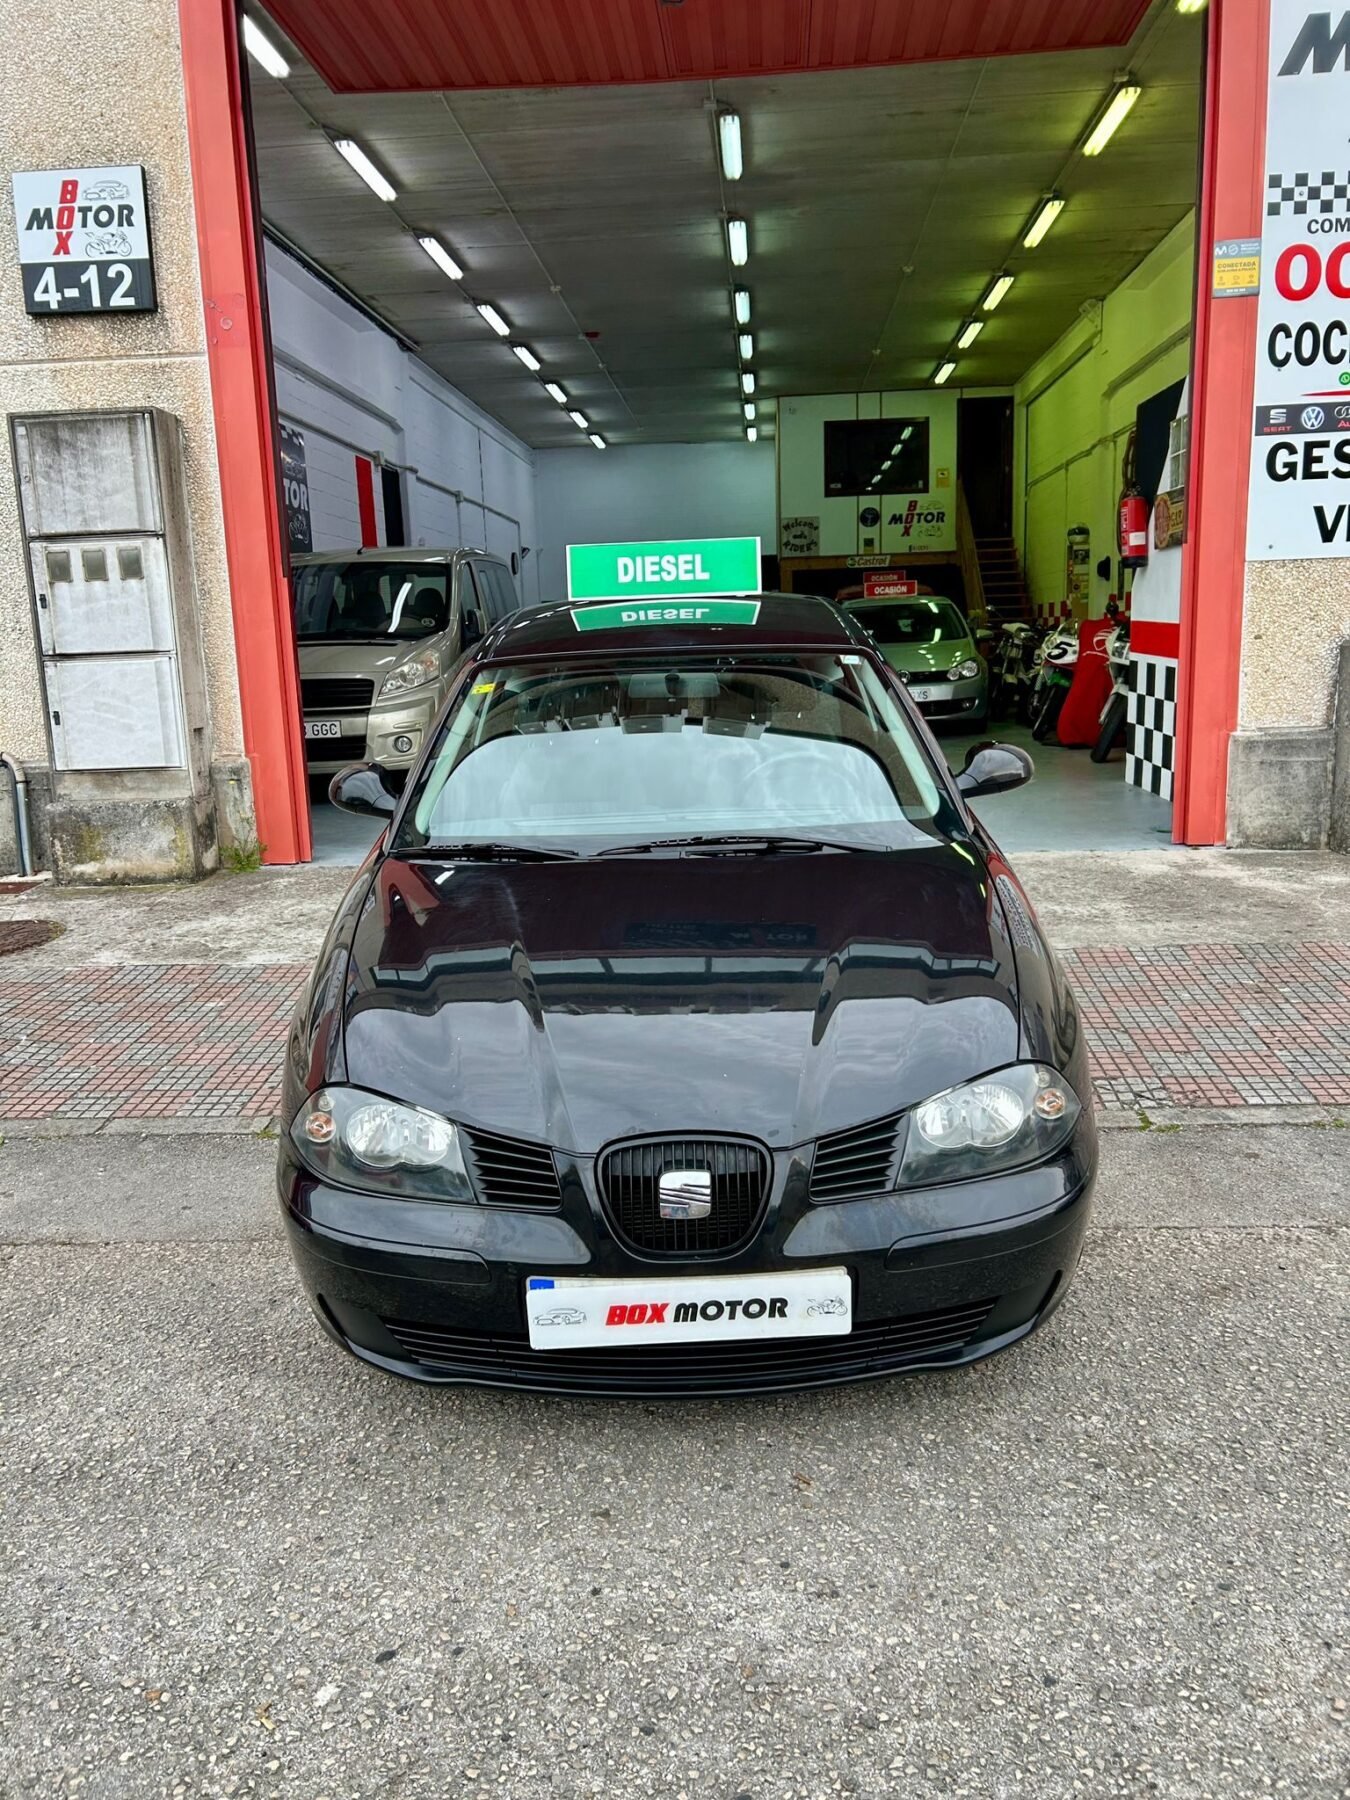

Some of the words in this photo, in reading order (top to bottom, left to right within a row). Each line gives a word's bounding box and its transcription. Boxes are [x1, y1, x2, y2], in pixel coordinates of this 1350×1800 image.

[25, 204, 135, 231] MOTOR
[53, 180, 79, 256] BOX
[34, 263, 136, 310] 4-12
[1268, 320, 1350, 367] COC
[1263, 425, 1293, 433] SEAT
[1313, 504, 1350, 544] V
[617, 554, 710, 583] DIESEL
[858, 556, 887, 567] Castrol
[874, 584, 908, 594] OCASIÓN
[1046, 640, 1076, 660] 5
[311, 723, 338, 737] GGC
[605, 1302, 670, 1327] BOX
[673, 1297, 789, 1323] MOTOR
